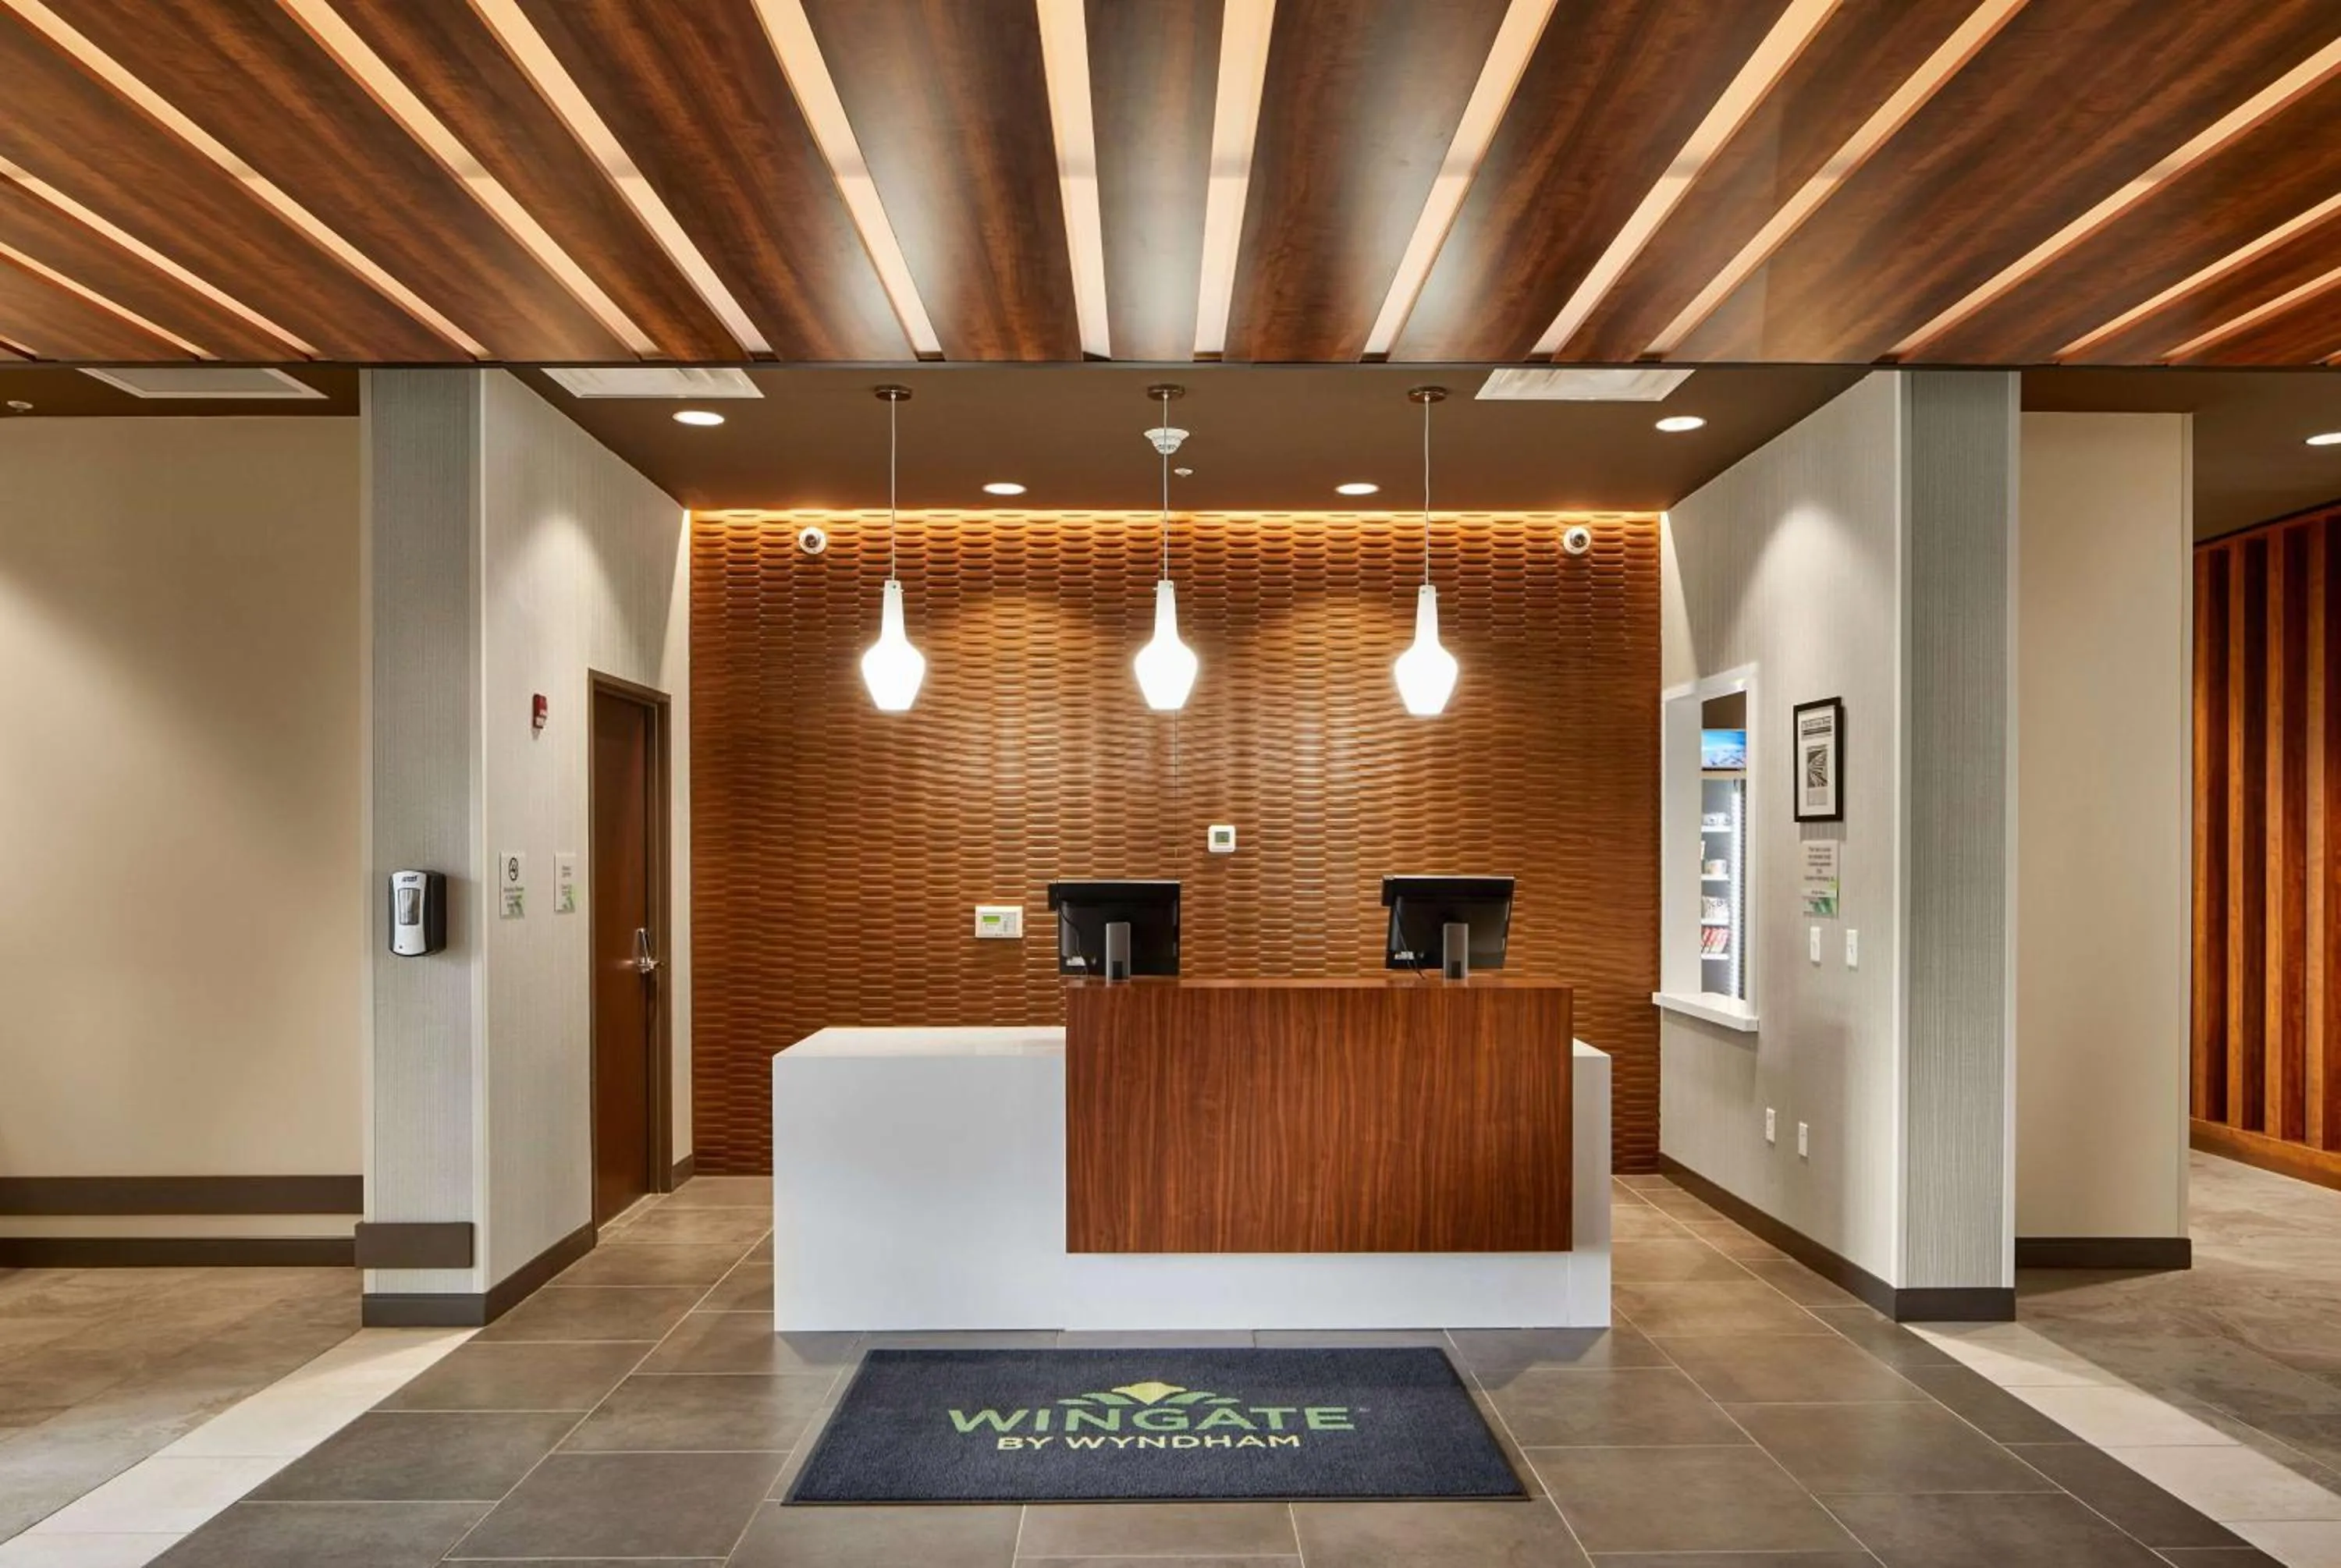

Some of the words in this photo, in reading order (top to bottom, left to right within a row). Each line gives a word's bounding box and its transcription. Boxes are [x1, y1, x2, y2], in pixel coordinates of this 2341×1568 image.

[948, 1407, 1355, 1433] WINGATE
[997, 1436, 1053, 1450] BY
[1065, 1435, 1300, 1449] WYNDHAM
